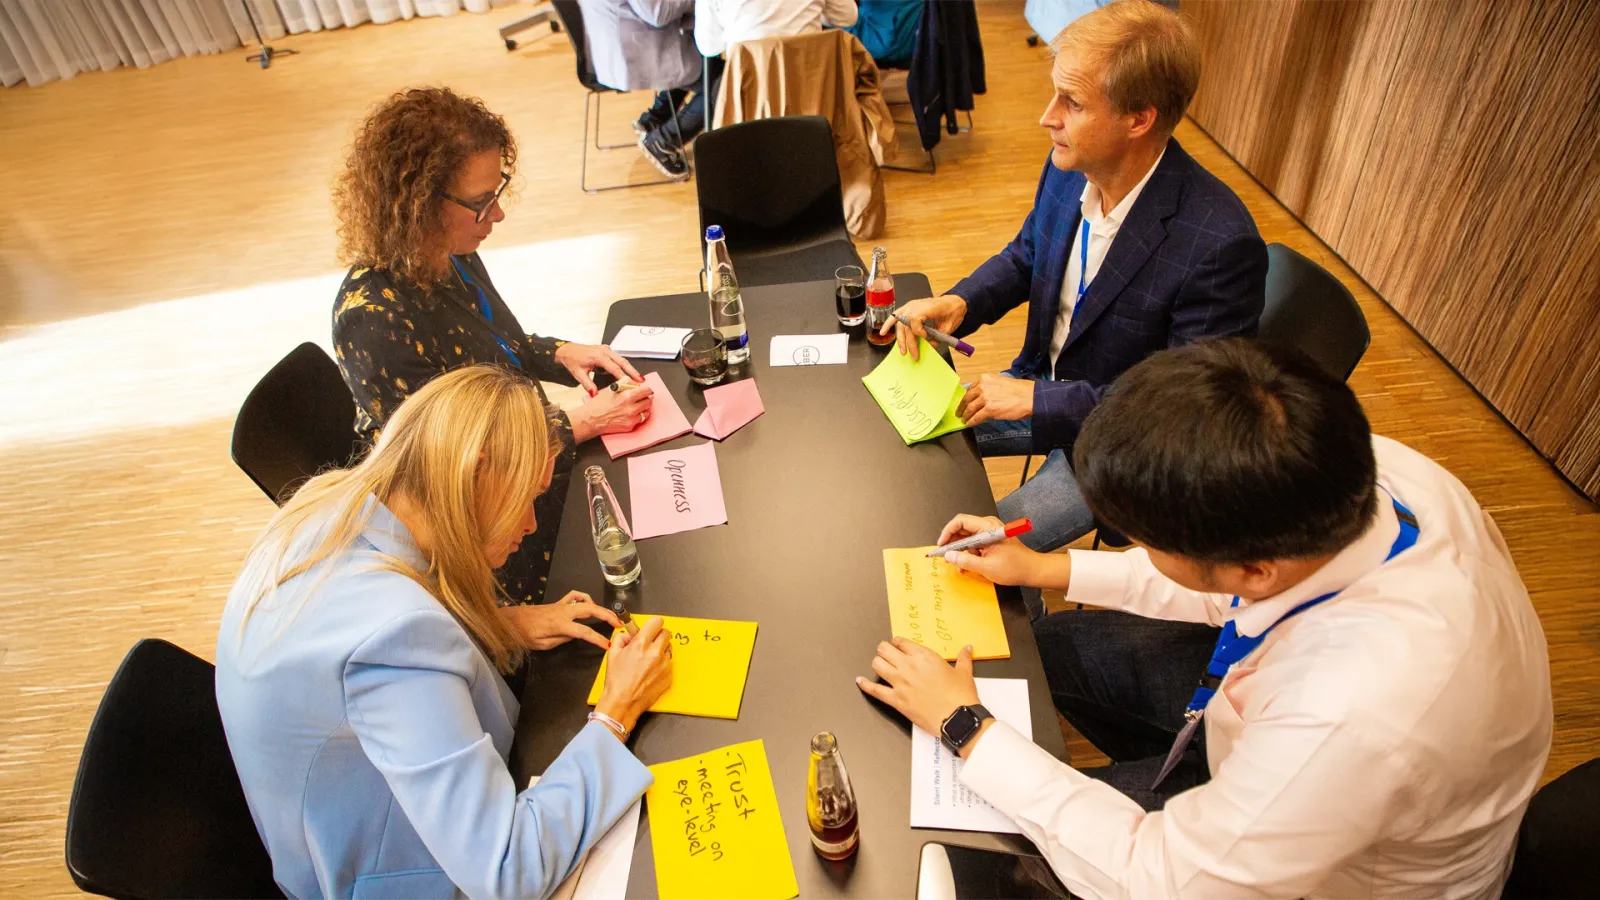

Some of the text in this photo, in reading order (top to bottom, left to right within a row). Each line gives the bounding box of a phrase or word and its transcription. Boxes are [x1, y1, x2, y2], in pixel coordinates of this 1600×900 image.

[664, 459, 691, 513] Openness
[703, 630, 721, 642] to
[933, 737, 941, 806] Silent Walk Reflectio
[710, 841, 723, 861] on
